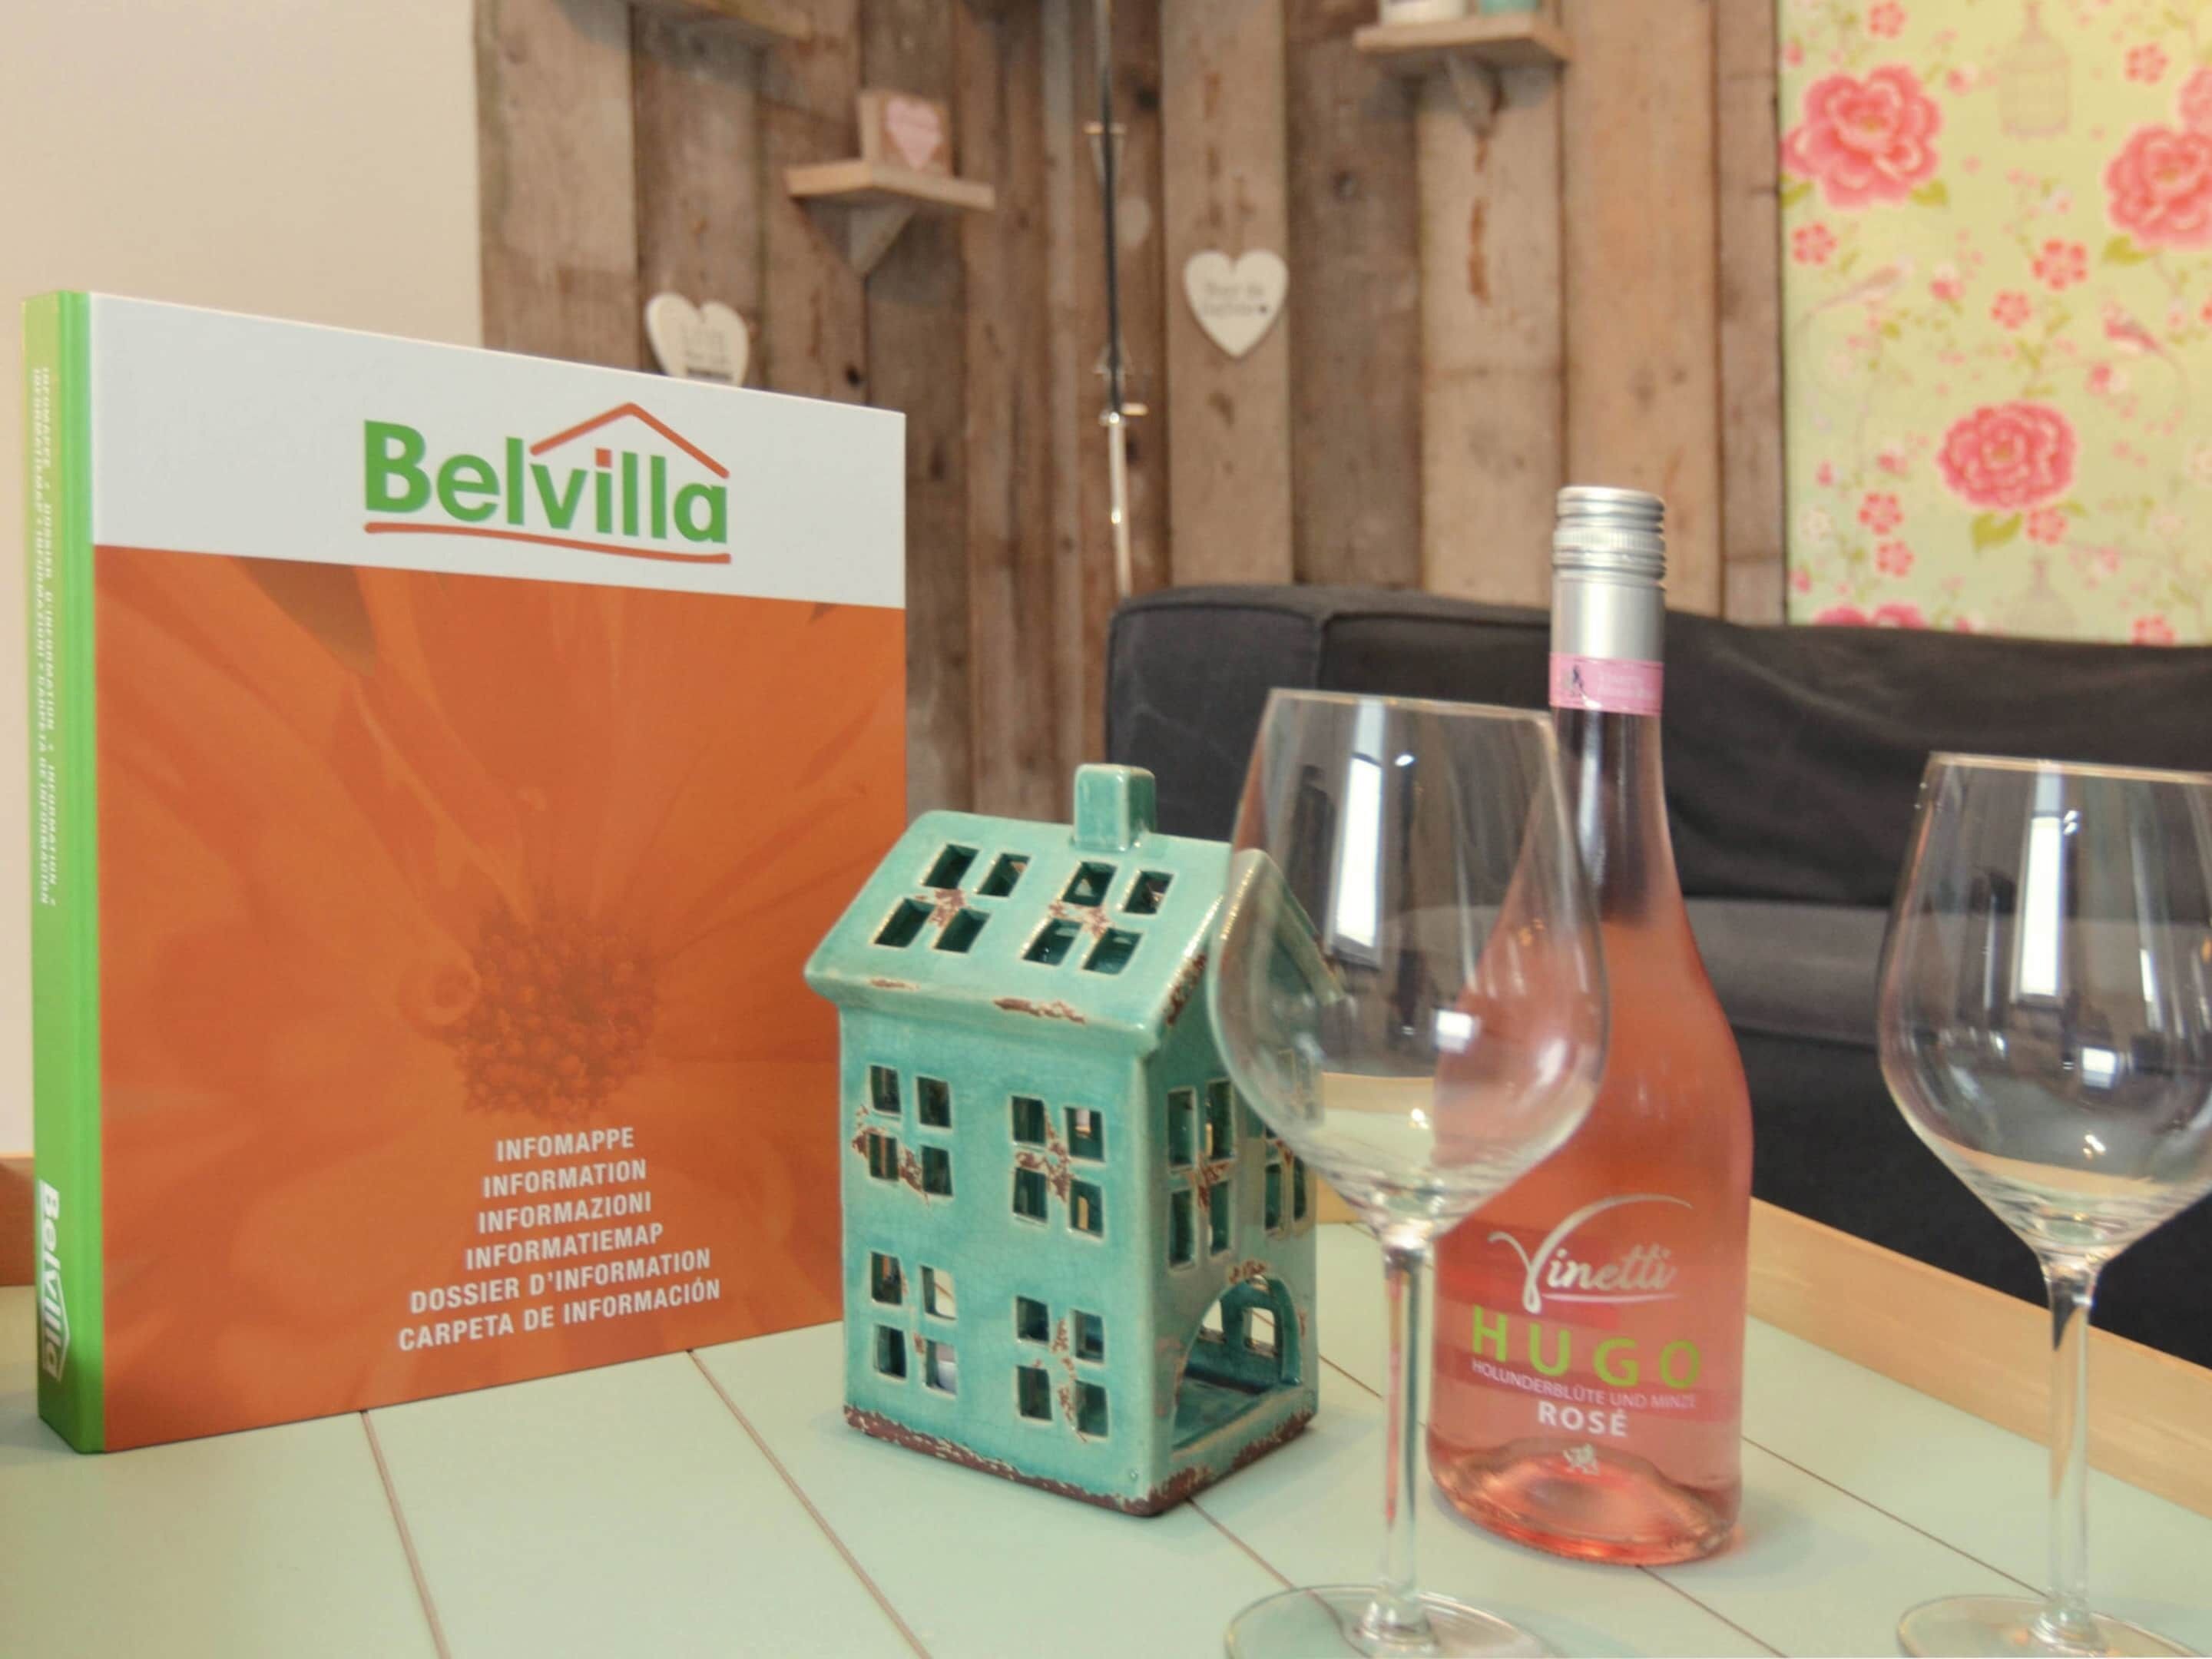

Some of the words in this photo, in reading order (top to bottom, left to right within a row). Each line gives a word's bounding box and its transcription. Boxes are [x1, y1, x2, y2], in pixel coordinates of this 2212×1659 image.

[364, 419, 728, 544] Belvilla
[495, 1127, 635, 1162] INFOMAPPE
[482, 1159, 647, 1198] INFORMATION
[478, 1191, 651, 1233] INFORMAZIONI
[465, 1223, 664, 1270] INFORMATIEMAP
[1487, 1193, 1694, 1314] Vinetti
[38, 1179, 61, 1381] Belvilla
[410, 1277, 520, 1313] DOSSIER
[530, 1248, 711, 1296] D'INFORMATION
[398, 1313, 515, 1351] CARPETA
[524, 1306, 554, 1331] DE
[564, 1277, 720, 1324] INFORMACIÓN
[1472, 1305, 1700, 1389] HUGO
[1538, 1400, 1628, 1437] ROSÉ
[1609, 1392, 1647, 1409] UND
